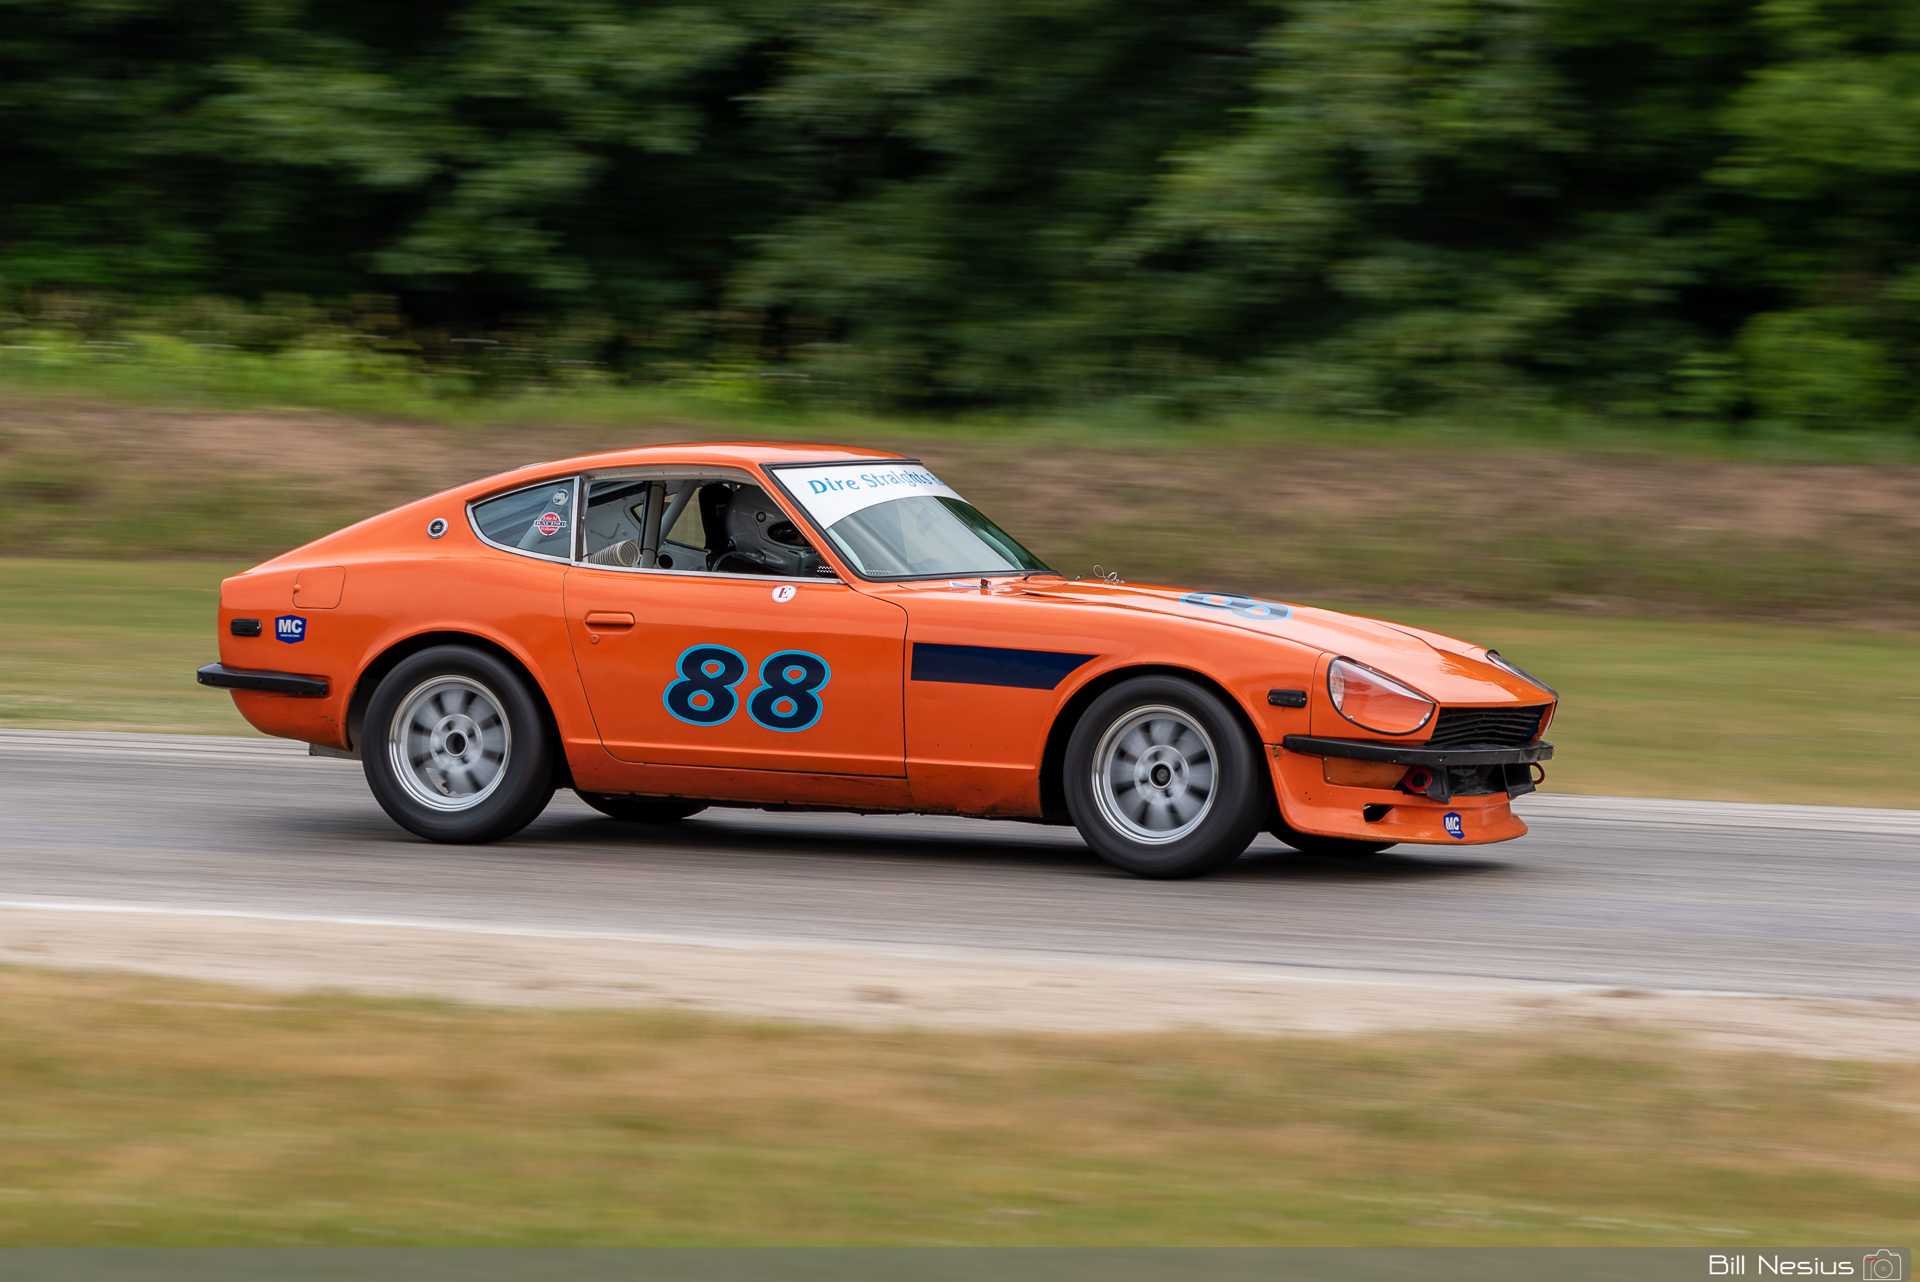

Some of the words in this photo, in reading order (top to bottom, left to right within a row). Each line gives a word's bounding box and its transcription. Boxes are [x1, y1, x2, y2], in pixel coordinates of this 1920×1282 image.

[807, 477, 860, 495] Dire
[860, 470, 933, 487] Straights
[778, 587, 792, 599] E
[278, 619, 303, 634] MC
[662, 643, 832, 733] 88
[1445, 816, 1460, 831] MC
